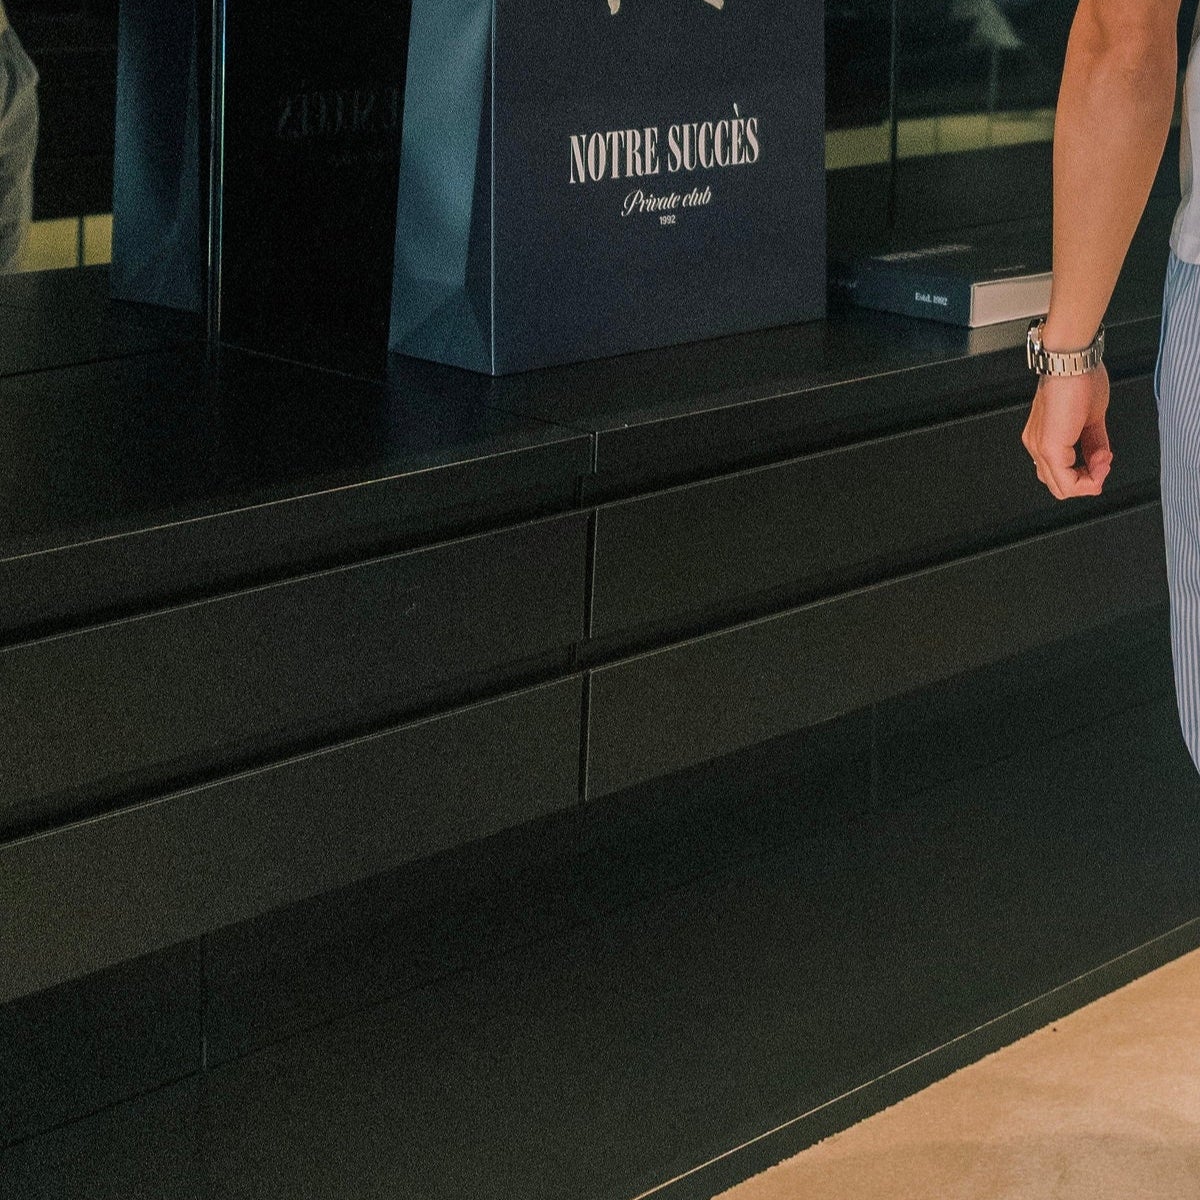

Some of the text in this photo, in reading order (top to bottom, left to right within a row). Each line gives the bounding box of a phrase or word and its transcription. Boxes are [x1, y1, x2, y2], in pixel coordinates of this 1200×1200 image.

[569, 102, 760, 183] NOTRE SUCCÈS
[620, 185, 712, 217] Private club
[659, 215, 676, 225] 1992
